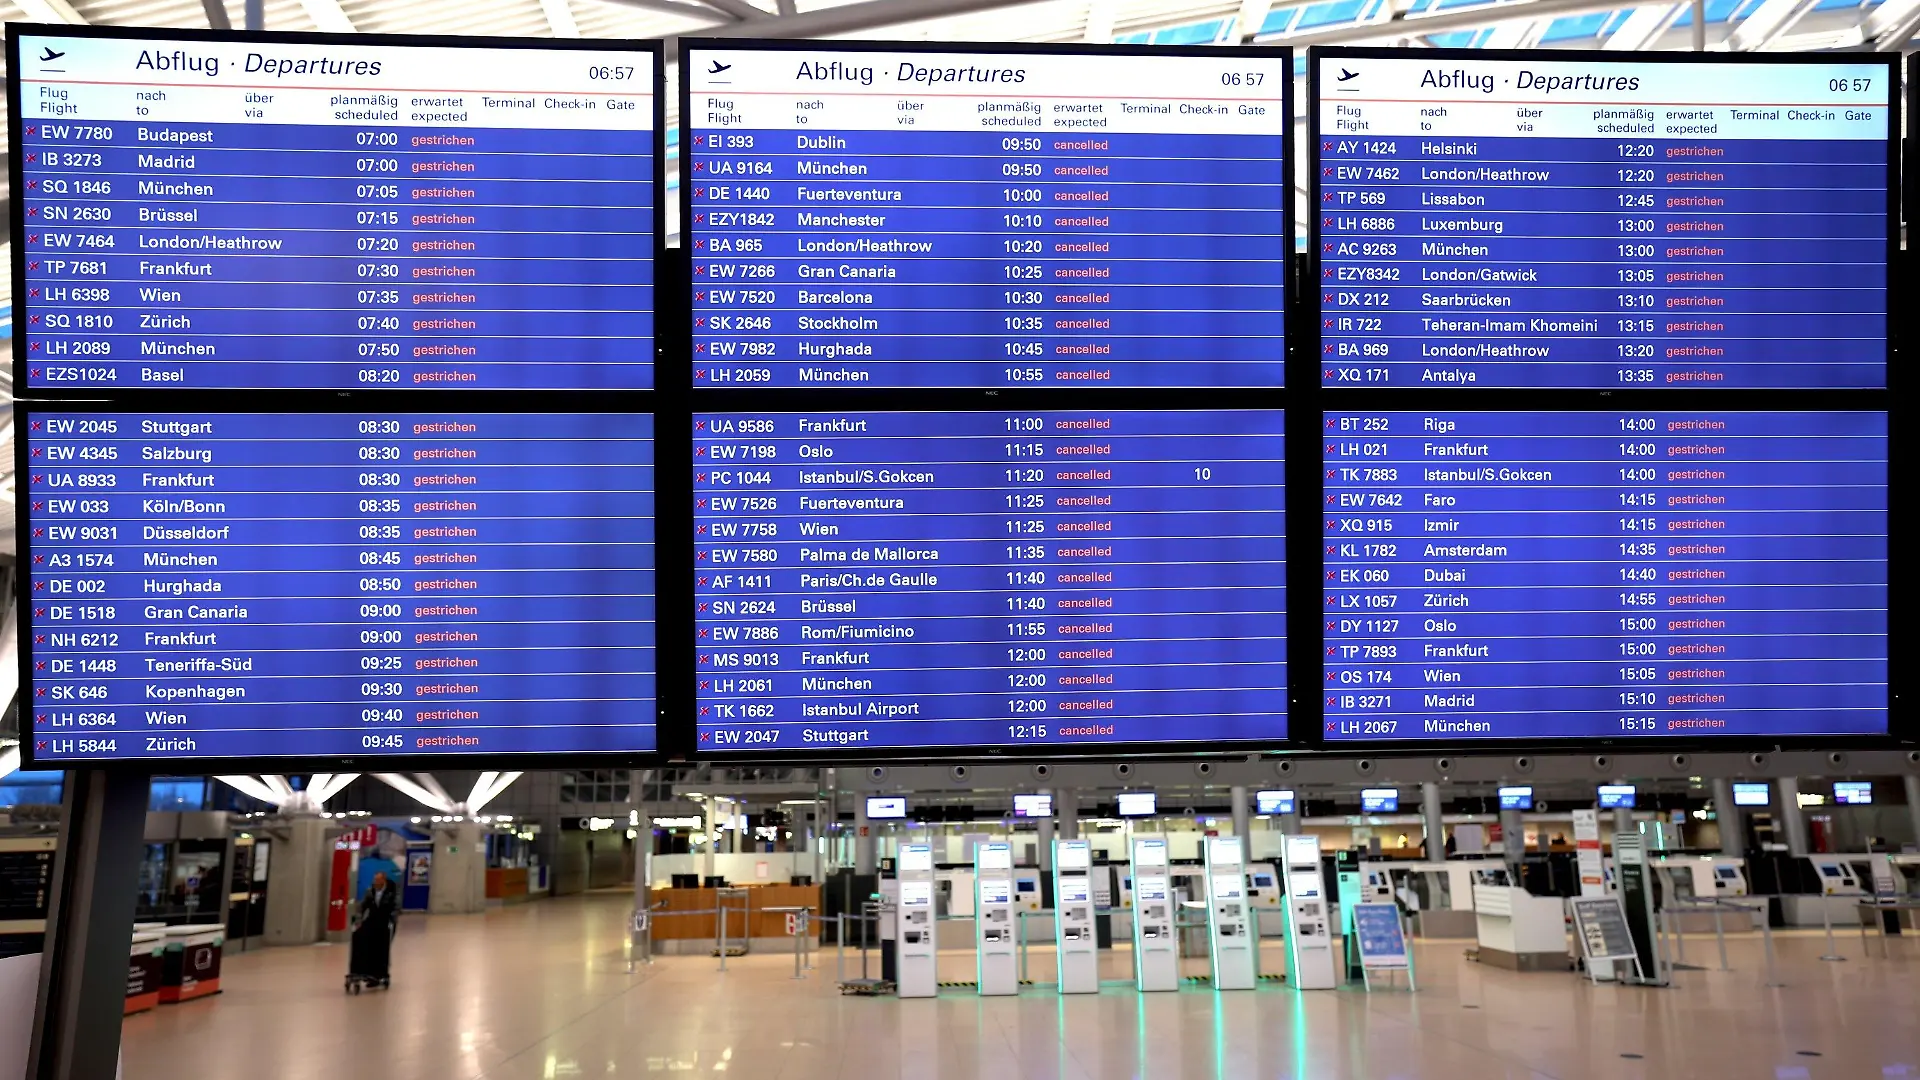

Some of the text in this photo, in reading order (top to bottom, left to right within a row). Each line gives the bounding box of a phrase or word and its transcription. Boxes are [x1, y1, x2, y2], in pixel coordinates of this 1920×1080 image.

[135, 49, 382, 79] Abflug Departures
[589, 66, 635, 80] 06:57
[795, 61, 1026, 87] Abflug Departures
[1420, 69, 1640, 94] Abflug Departures
[39, 86, 635, 110] Flug nach über planmäßig erwartet Terminal Check-in Gate
[40, 101, 468, 124] Flight to via scheduled expected
[707, 98, 1266, 116] Flug nach über planmäßig erwartet Terminal Check-in Gate
[1336, 104, 1872, 122] Flug nach über planmäßig erwartet Terminal Check-in Gate
[707, 112, 1107, 129] Flight to via scheduled expected
[1336, 119, 1718, 136] Flight to via scheduled expected
[41, 124, 475, 147] EW 7780 Budapest 07:00 gestrichen
[1336, 140, 1724, 158] AY 1424 Helsinki 12:20 gestrichen
[709, 186, 1109, 202] DE 1440 Fuerteventura 10:00 cancelled
[43, 205, 475, 226] SN 2630 Brüssel 07:15 gestrichen
[709, 238, 1109, 253] BA 965 London/Heathrow 10:20 cancelled
[1337, 267, 1724, 283] EZY8342 London/Gatwick 13:05 gestrichen
[45, 287, 476, 305] LH 6398 Wien 07:35 gestrichen
[709, 316, 1110, 330] SK 2646 Stockholm 10:35 cancelled
[1338, 317, 1724, 333] IR 722 Teheran-Imam Khomeini 13:15 gestrichen
[46, 367, 477, 384] EZS1024 Basel 08:20 gestrichen
[711, 467, 1211, 485] PC 1044 Istanbul/S.Gokcen 11:20 cancelled 10
[1339, 467, 1725, 482] TK 7883 Istanbul/S.Gokcen 14:00 gestrichen
[48, 499, 477, 514] EW 033 Köln/Bonn 08:35 gestrichen
[1340, 542, 1726, 557] KL 1782 Amsterdam 14:35 gestrichen
[711, 571, 1112, 589] AF 1411 Paris/Ch.de Gaulle 11:40 cancelled
[50, 604, 478, 620] DE 1518 Gran Canaria 09:00 gestrichen
[51, 656, 478, 673] DE 1448 Teneriffa-Süd 09:25 gestrichen
[714, 673, 1113, 693] LH 2061 München 12:00 cancelled
[1340, 667, 1725, 684] OS 174 Wien 15:05 gestrichen
